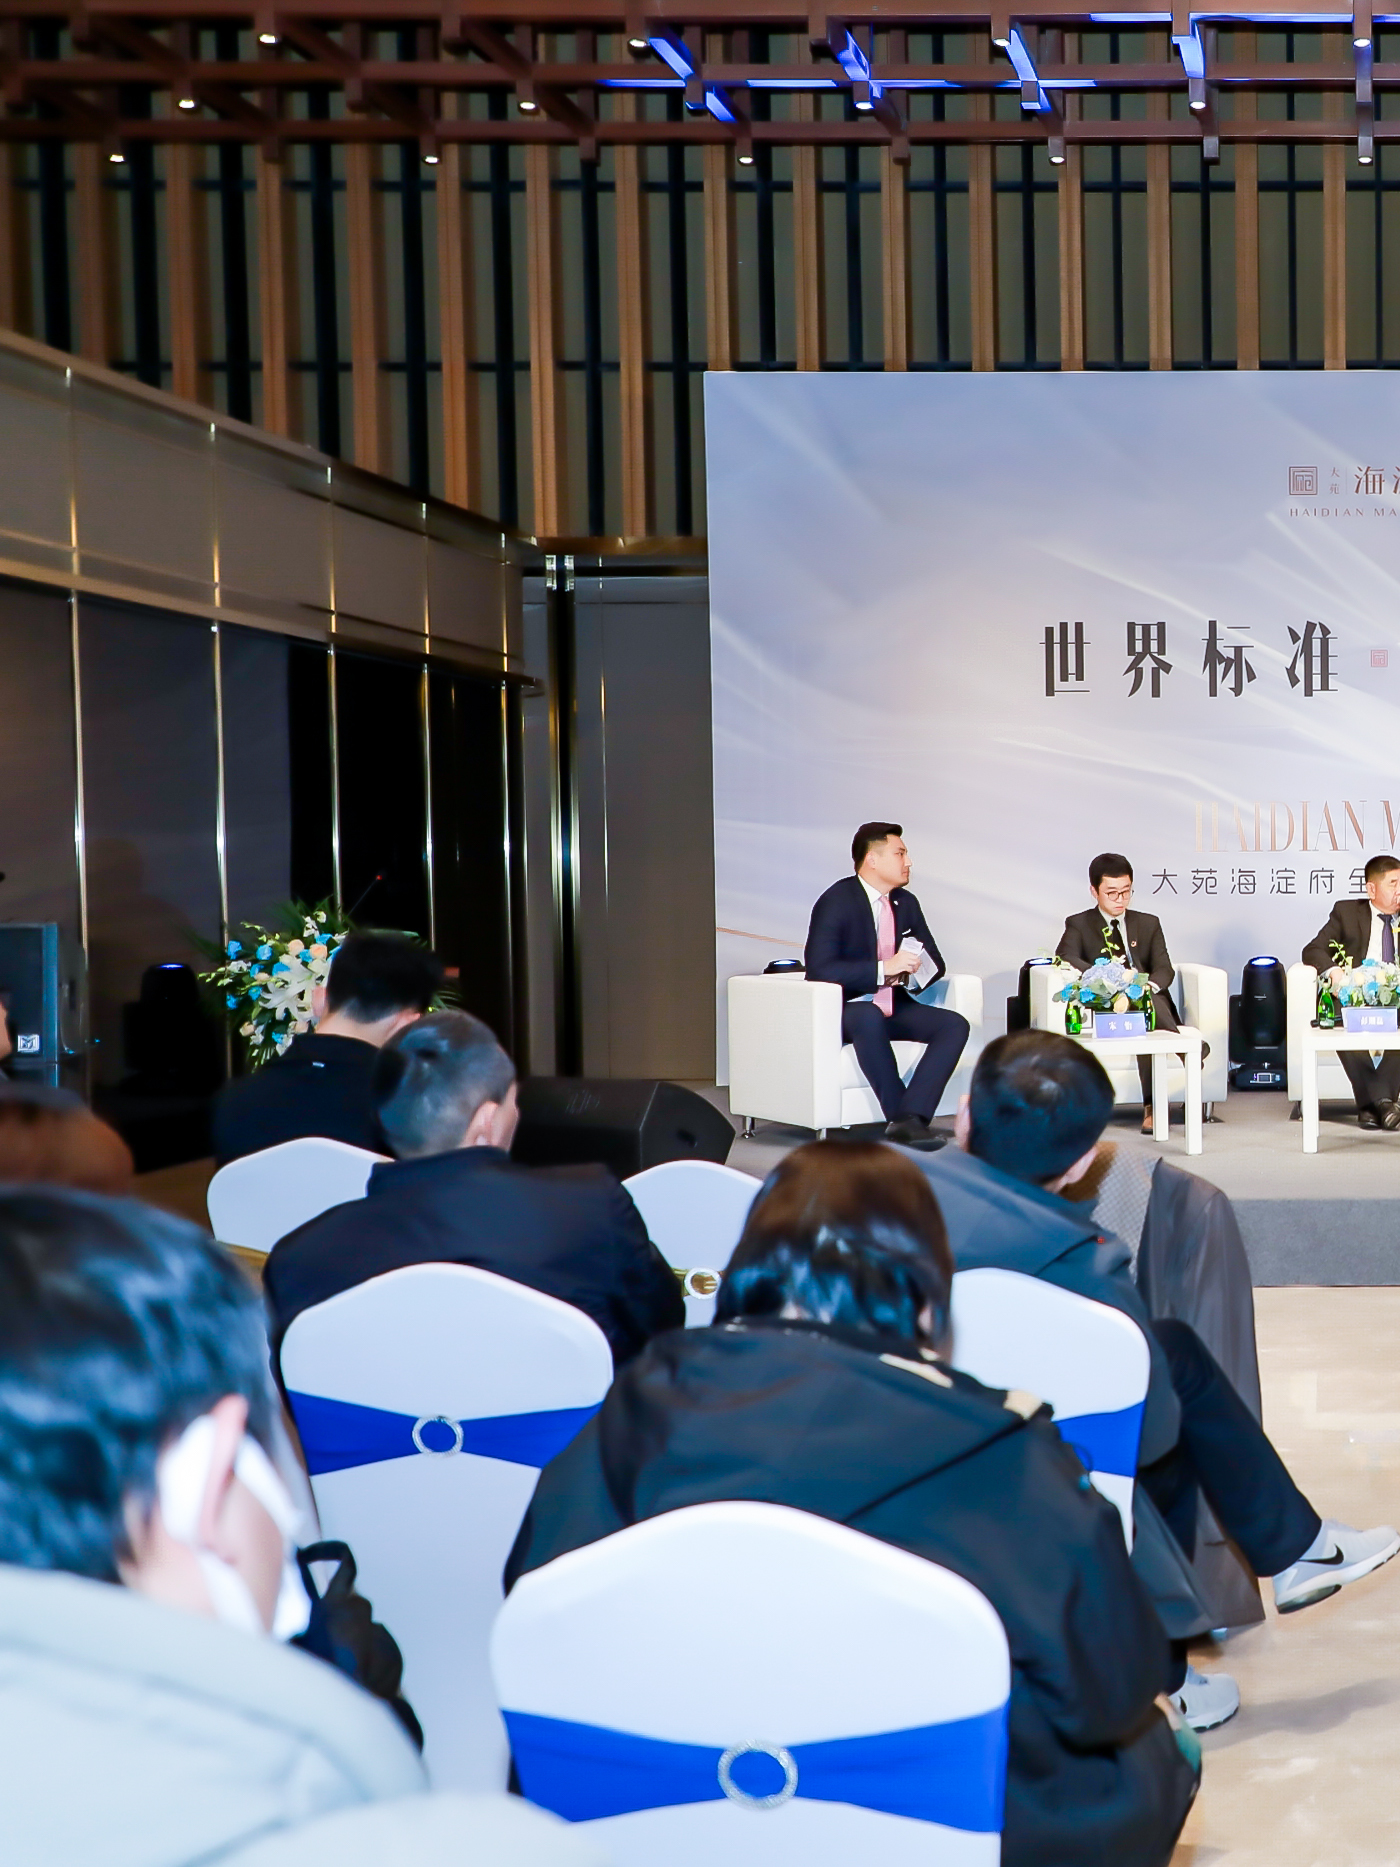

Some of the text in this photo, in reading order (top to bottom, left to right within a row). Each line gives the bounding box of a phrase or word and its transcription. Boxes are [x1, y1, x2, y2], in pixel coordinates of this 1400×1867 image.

[1329, 467, 1340, 495] 大苑
[1290, 508, 1364, 517] HAIDIAN
[1039, 620, 1338, 698] 世界标准
[1194, 800, 1367, 853] HAIDIAN
